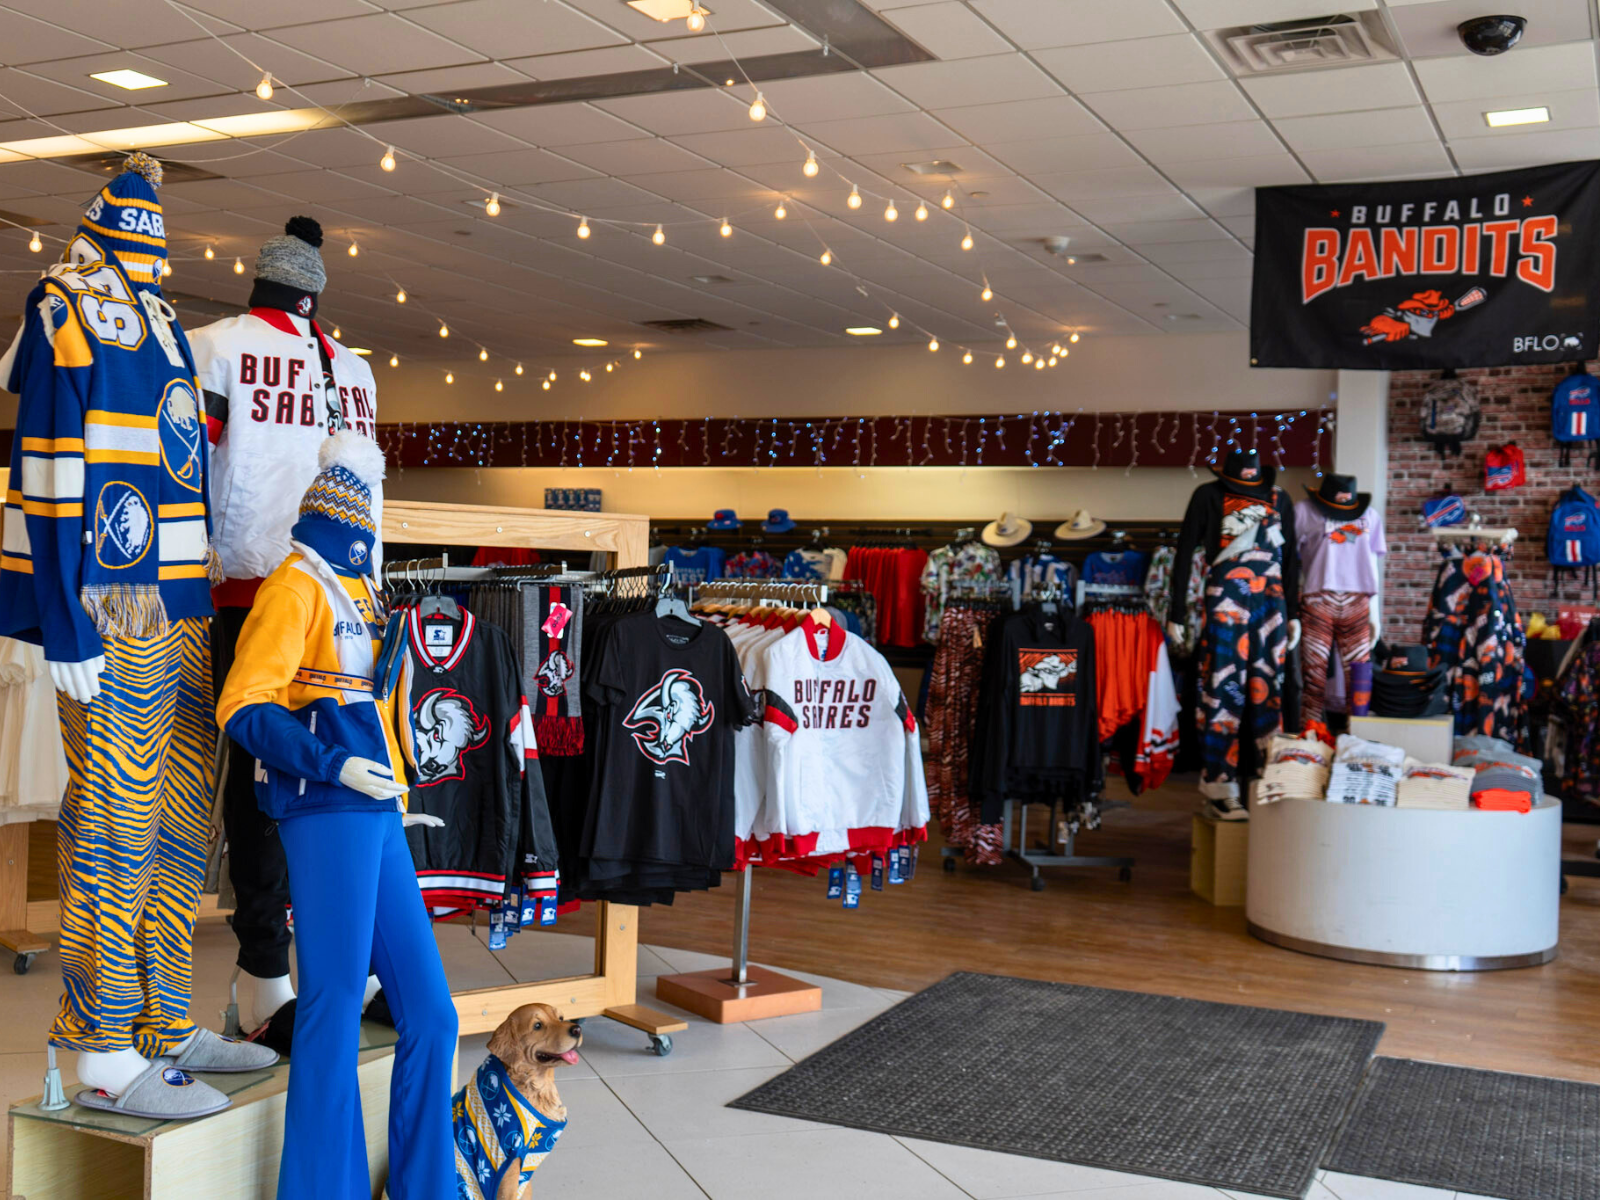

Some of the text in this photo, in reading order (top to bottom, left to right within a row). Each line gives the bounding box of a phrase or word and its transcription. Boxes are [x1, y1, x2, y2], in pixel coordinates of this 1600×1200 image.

[1351, 193, 1510, 224] BUFFALO
[1302, 214, 1558, 305] BANDITS
[1513, 334, 1560, 352] BFLO
